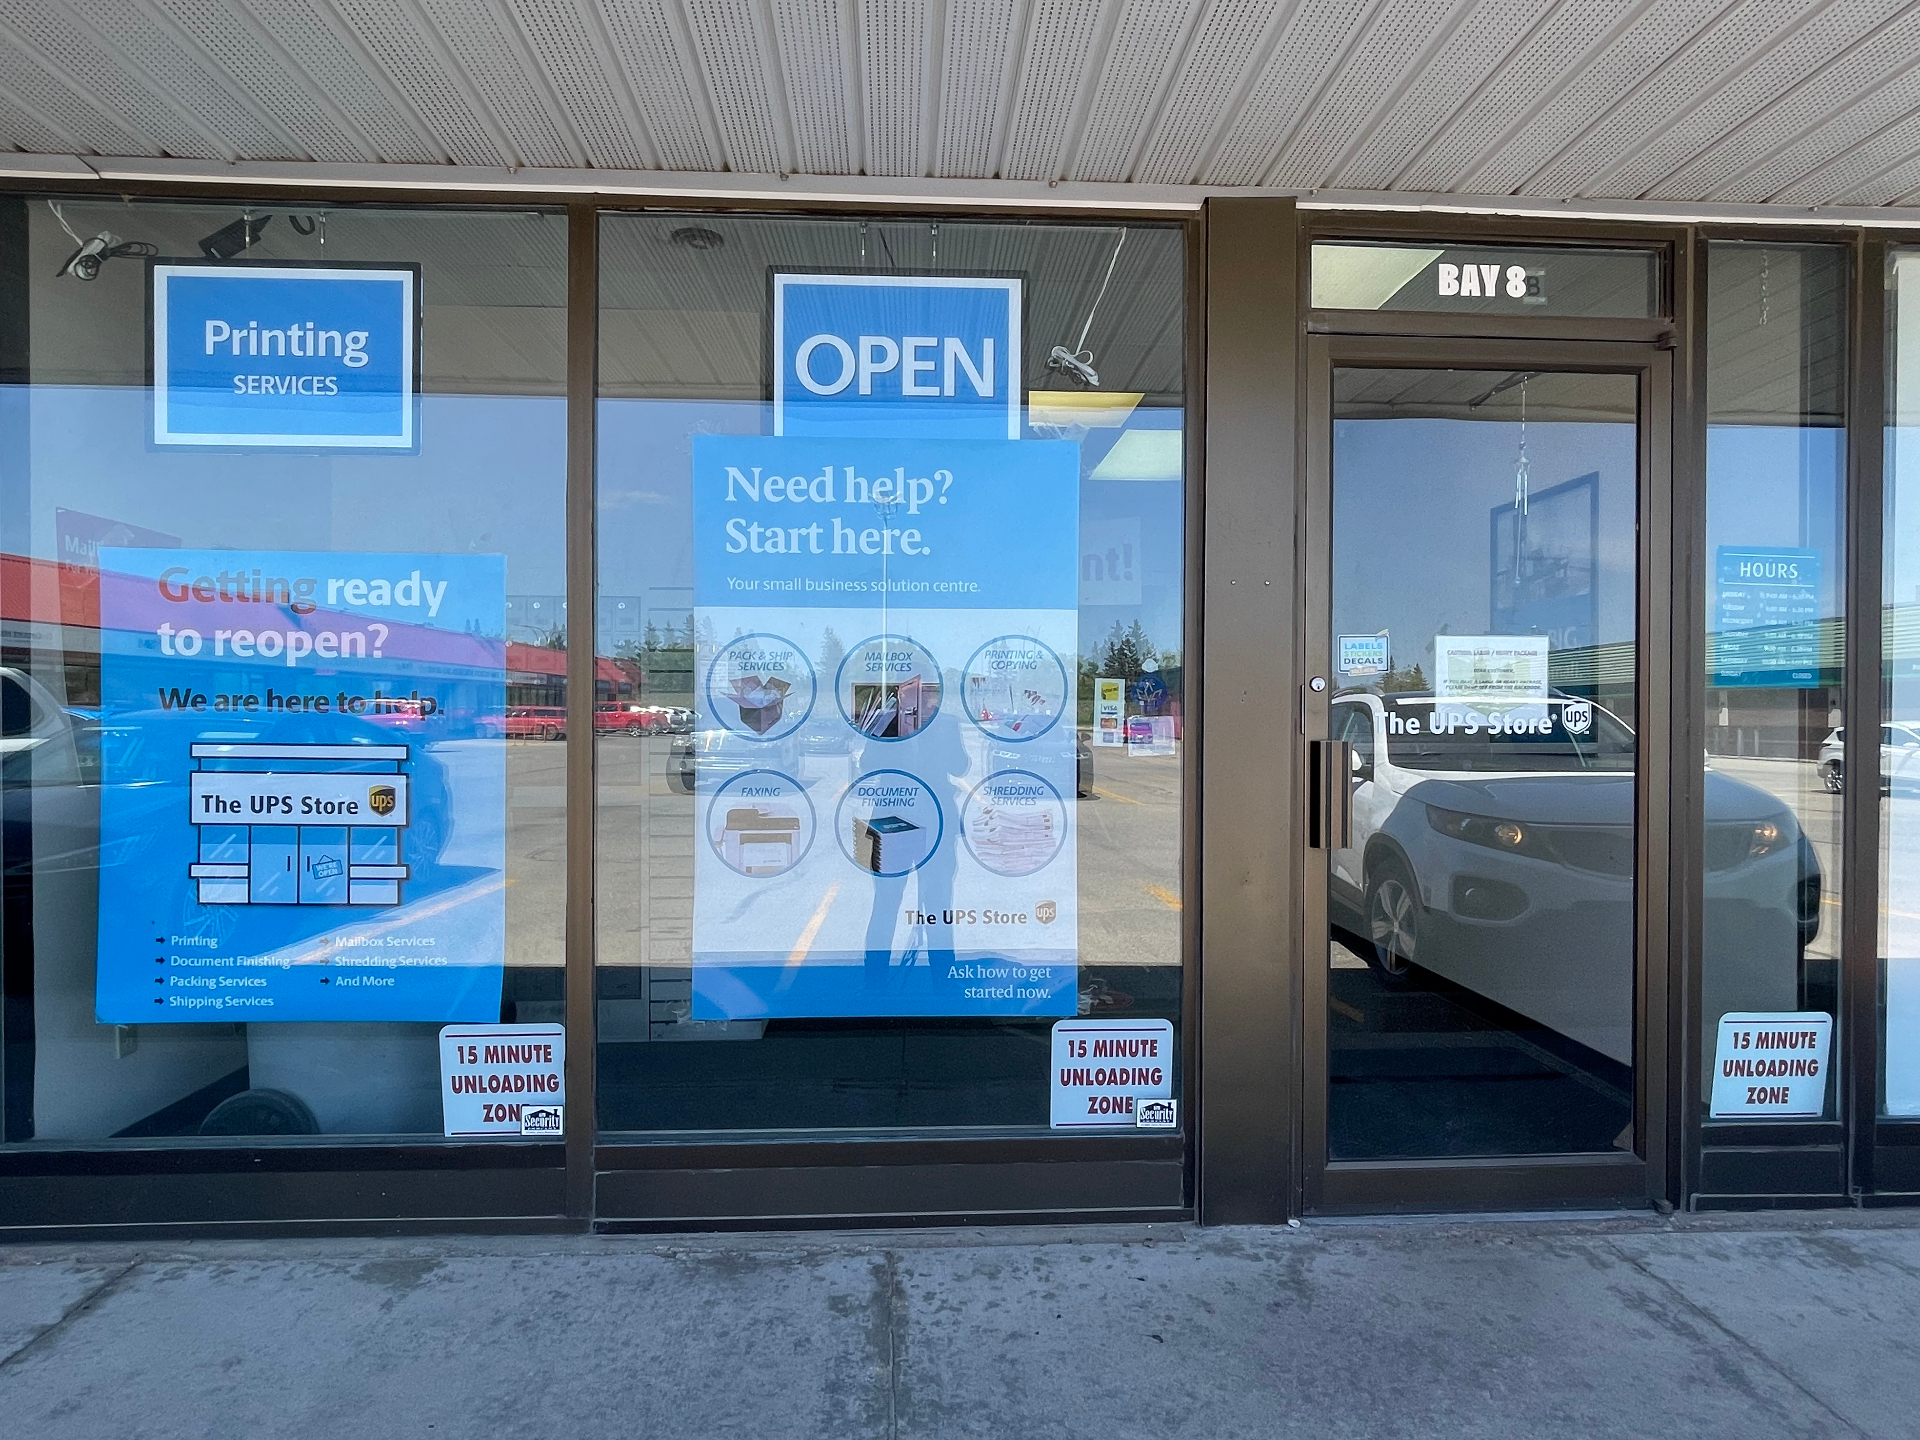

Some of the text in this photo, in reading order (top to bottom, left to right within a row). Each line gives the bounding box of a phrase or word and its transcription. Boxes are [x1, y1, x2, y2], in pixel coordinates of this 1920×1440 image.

[1438, 263, 1501, 297] BAY
[205, 319, 369, 368] Printing
[795, 333, 995, 398] OPEN
[233, 374, 339, 396] SERVICES
[723, 465, 954, 515] Need help?
[725, 517, 931, 556] Start here.
[65, 534, 99, 558] Mail
[1081, 543, 1133, 582] nt!
[1740, 561, 1799, 579] HOURS
[159, 566, 448, 617] Getting ready
[727, 576, 981, 594] Your small business solution centre.
[157, 622, 389, 667] to reopen?
[1344, 642, 1383, 650] LABELS
[729, 651, 793, 662] PACK & SHIP
[864, 652, 913, 662] MAILBOX
[984, 649, 1044, 660] PRINTING &
[1343, 657, 1384, 665] DECALS
[737, 661, 785, 672] SERVICES
[865, 662, 912, 673] SERVICES
[991, 660, 1037, 671] COPYING
[158, 687, 445, 722] We are here to help.
[1375, 711, 1420, 735] The
[1428, 711, 1480, 735] UPS
[1565, 709, 1589, 728] ups
[741, 787, 781, 797] FAXING
[857, 787, 920, 797] DOCUMENT
[983, 786, 1044, 796] SHREDDING
[201, 793, 394, 815] The UPS Store ups
[861, 797, 916, 808] FINISHING
[990, 797, 1037, 806] SERVICES
[317, 868, 339, 878] OPEN
[905, 907, 1055, 925] The UPS Store ups
[171, 935, 218, 949] Printing
[335, 936, 436, 947] Mailbox Services
[170, 955, 291, 970] Document Finishing
[335, 955, 448, 969] Shredding Services
[170, 975, 268, 989] Packing Services
[335, 976, 396, 987] And More
[947, 965, 1052, 982] Ask how to get
[964, 985, 1052, 999] started now.
[169, 995, 275, 1009] Shipping Services
[1068, 1039, 1158, 1058] 15 MINUTE
[1733, 1031, 1818, 1050] 15 MINUTE
[457, 1044, 553, 1065] 15 MINUTE
[1723, 1058, 1819, 1077] UNLOADING
[451, 1073, 560, 1095] UNLOADING
[1060, 1067, 1163, 1087] UNLOADING
[1745, 1086, 1790, 1105] ZONE
[483, 1103, 522, 1122] ZON
[1087, 1096, 1134, 1114] ZONE
